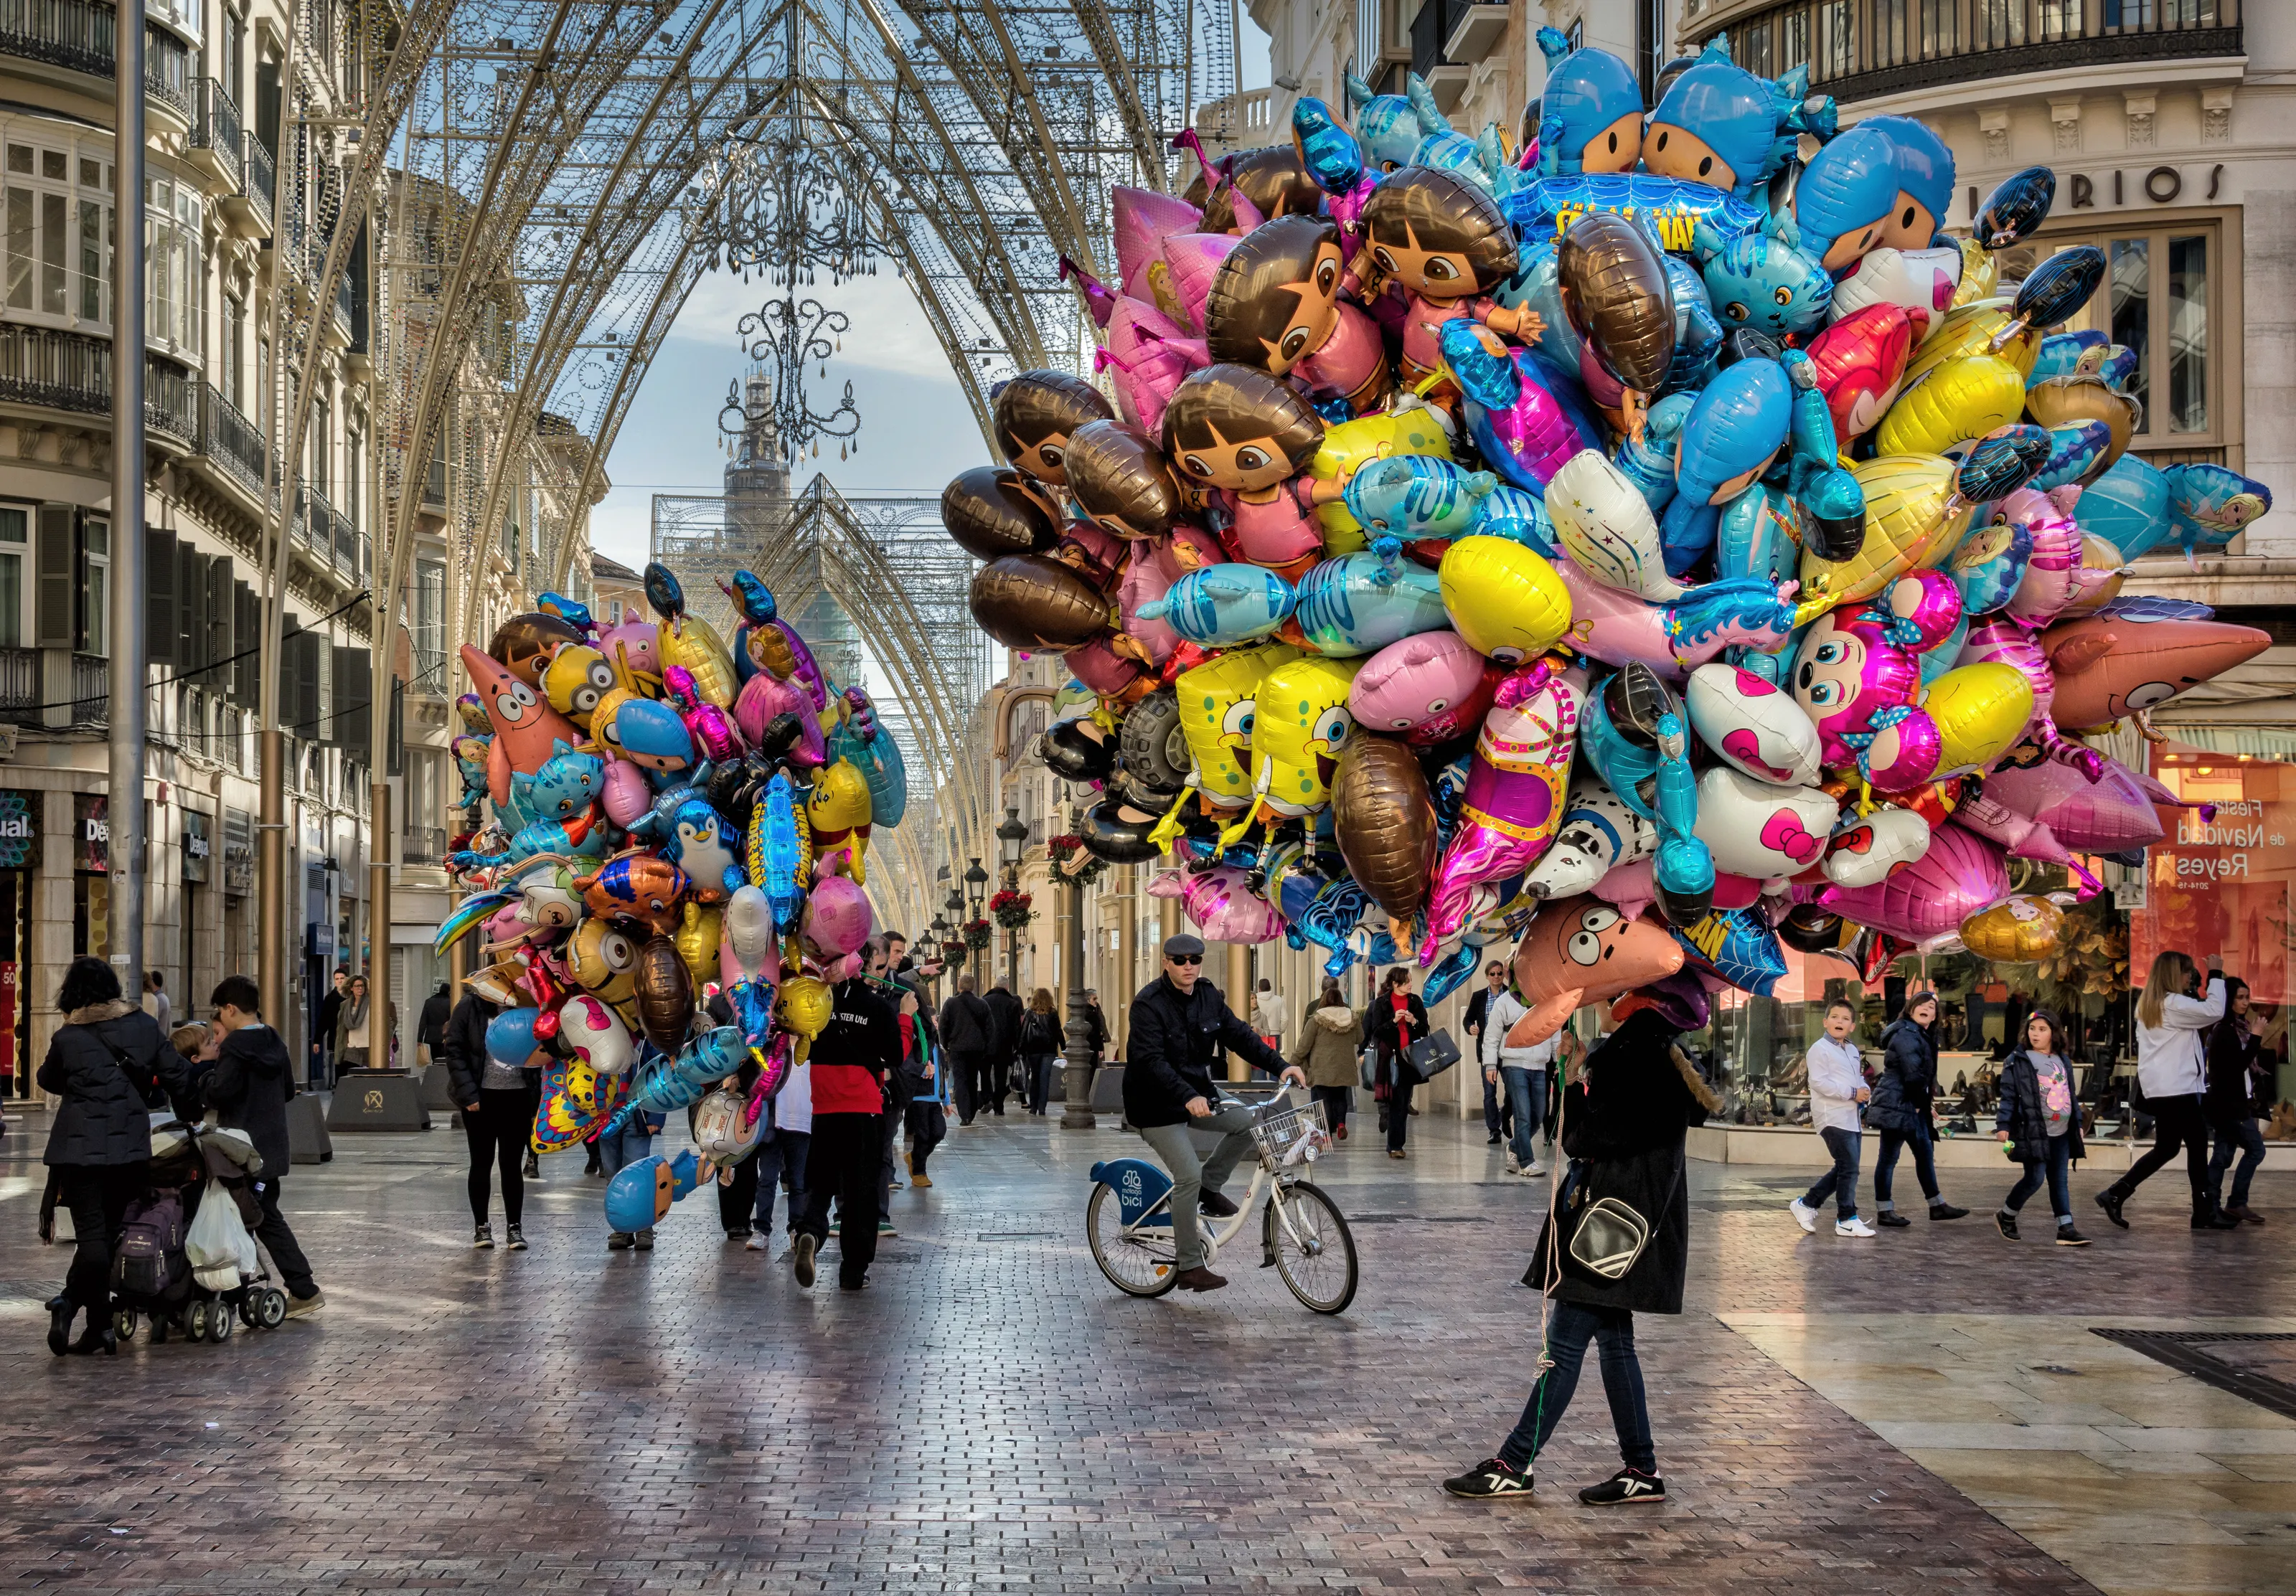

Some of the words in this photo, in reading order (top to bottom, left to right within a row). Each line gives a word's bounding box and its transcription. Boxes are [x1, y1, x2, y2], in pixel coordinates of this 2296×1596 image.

[1608, 207, 1701, 217] AMZING
[855, 1014, 868, 1025] Utd
[1121, 1194, 1142, 1207] bici
